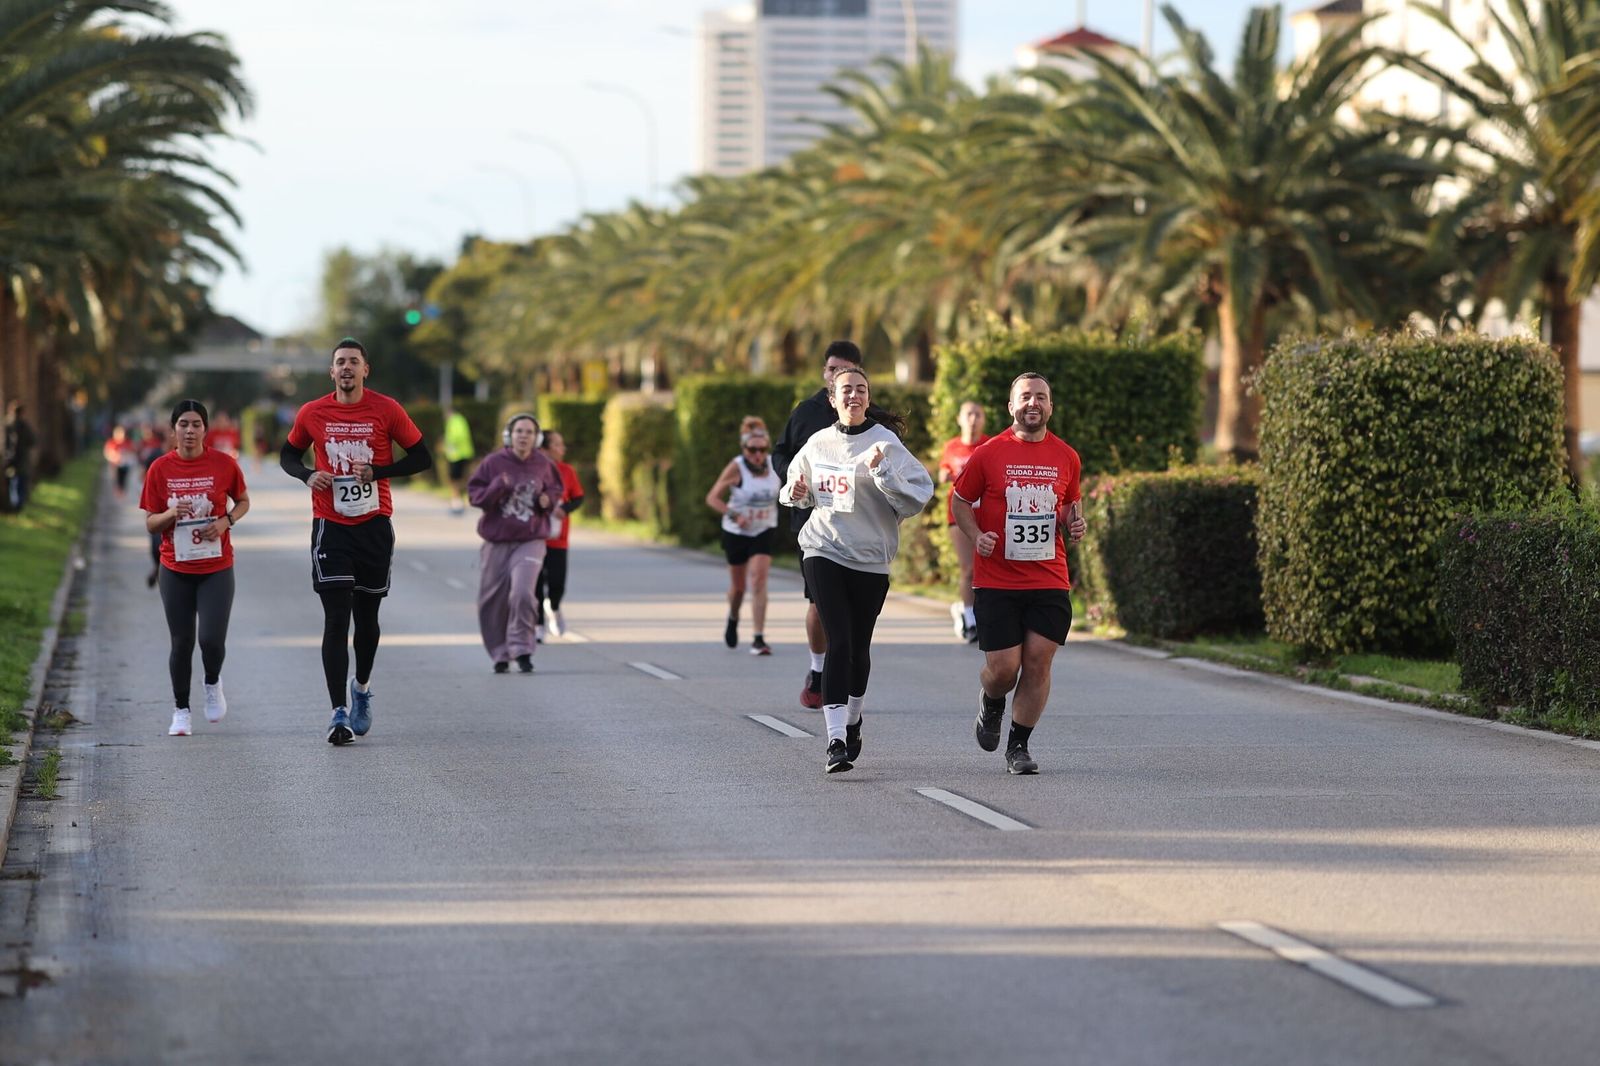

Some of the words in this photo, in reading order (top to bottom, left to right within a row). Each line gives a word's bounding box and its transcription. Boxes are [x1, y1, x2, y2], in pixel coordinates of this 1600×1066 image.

[818, 474, 849, 494] 105
[1034, 470, 1058, 478] JARDÍN
[339, 482, 373, 502] 299
[1013, 524, 1050, 544] 335
